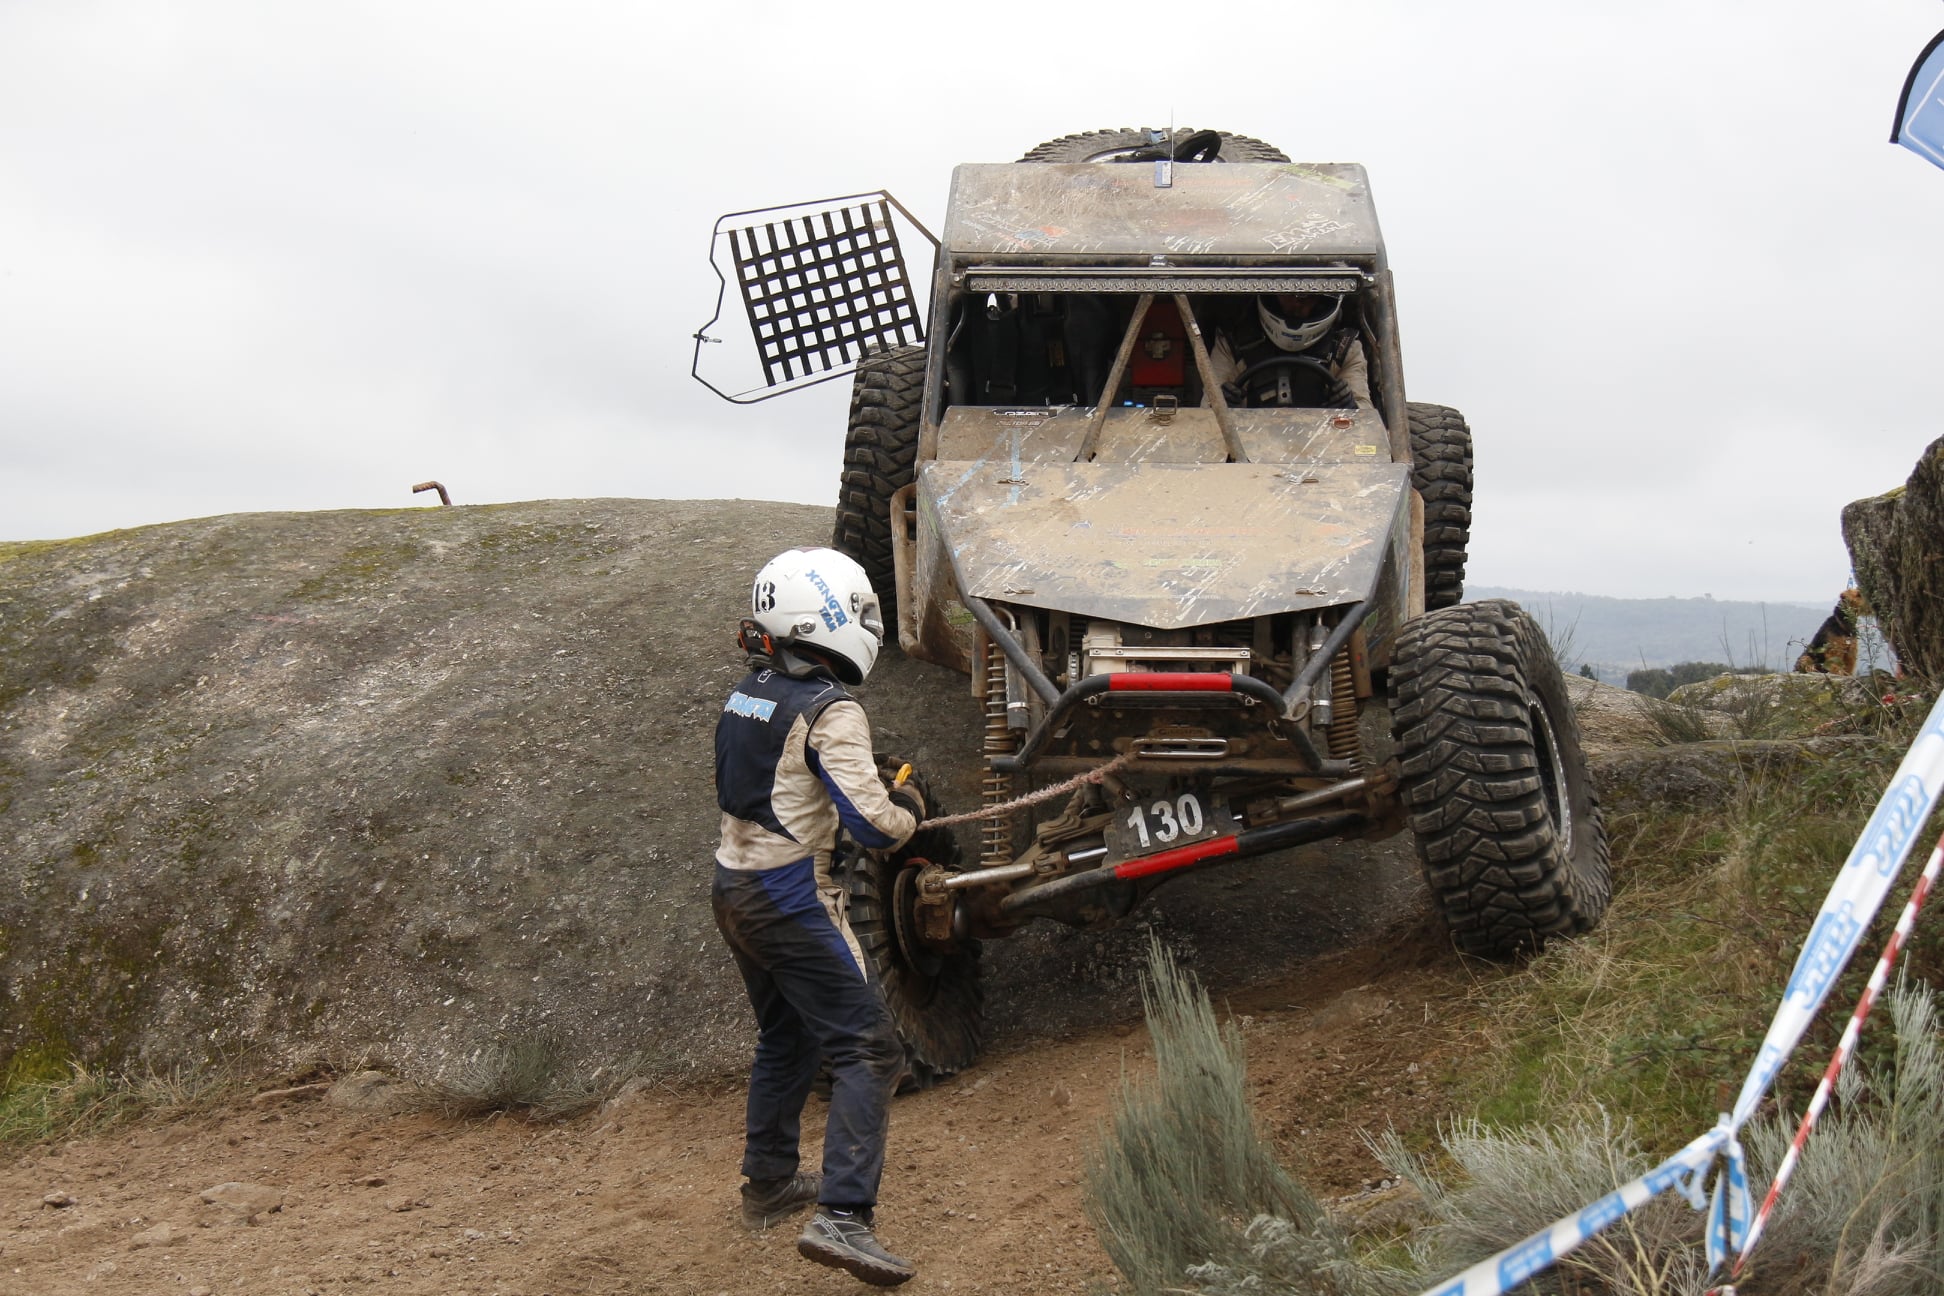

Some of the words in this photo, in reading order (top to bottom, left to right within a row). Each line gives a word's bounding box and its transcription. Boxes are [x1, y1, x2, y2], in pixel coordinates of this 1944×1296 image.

[755, 581, 776, 613] 13
[819, 606, 837, 632] TEAM
[1127, 793, 1203, 848] 130
